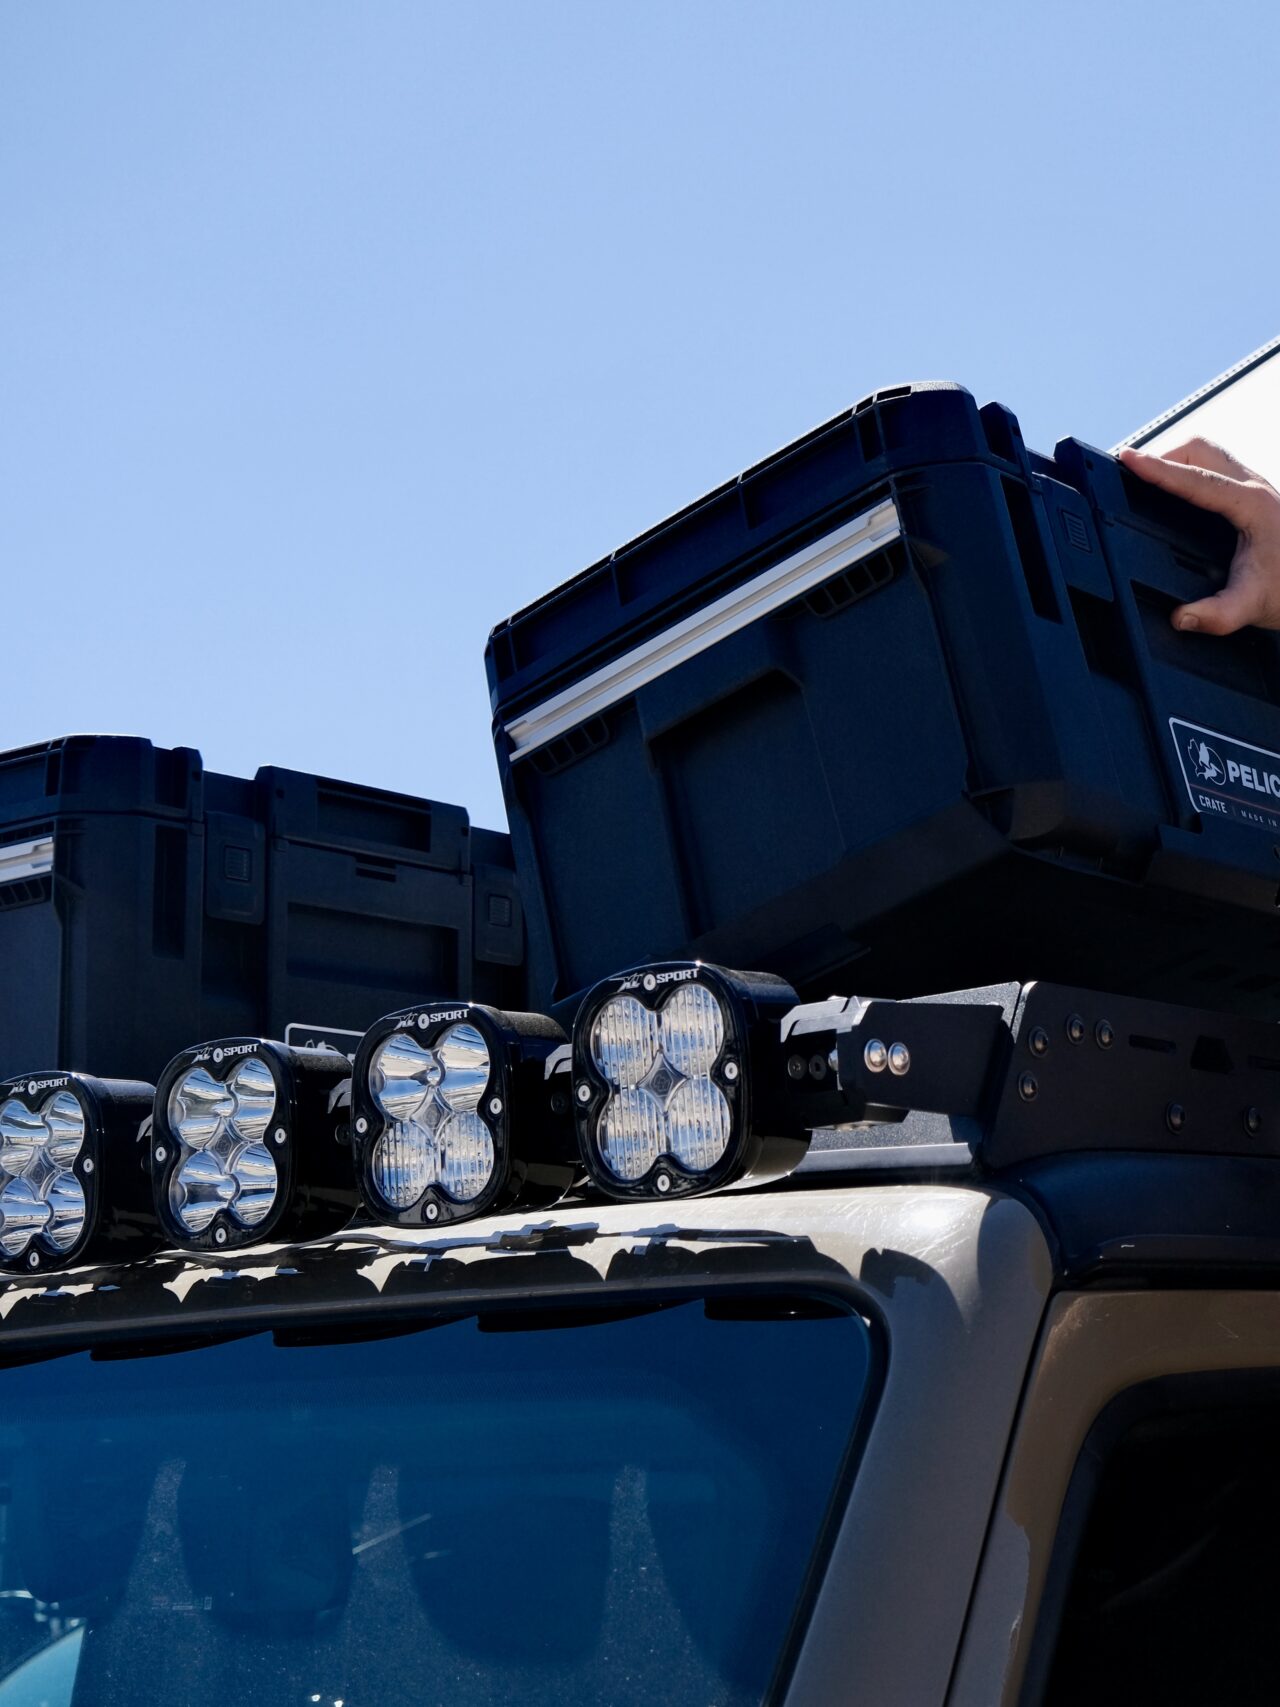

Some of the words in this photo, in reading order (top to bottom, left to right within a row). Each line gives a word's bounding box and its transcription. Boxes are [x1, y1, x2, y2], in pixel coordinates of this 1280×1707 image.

[1198, 794, 1228, 814] CRATE
[1240, 810, 1264, 824] MADE
[1268, 818, 1278, 827] IN
[656, 967, 699, 984] SPORT
[429, 1008, 470, 1023] SPORT
[223, 1043, 259, 1057] SPORT
[37, 1077, 69, 1090] SPORT
